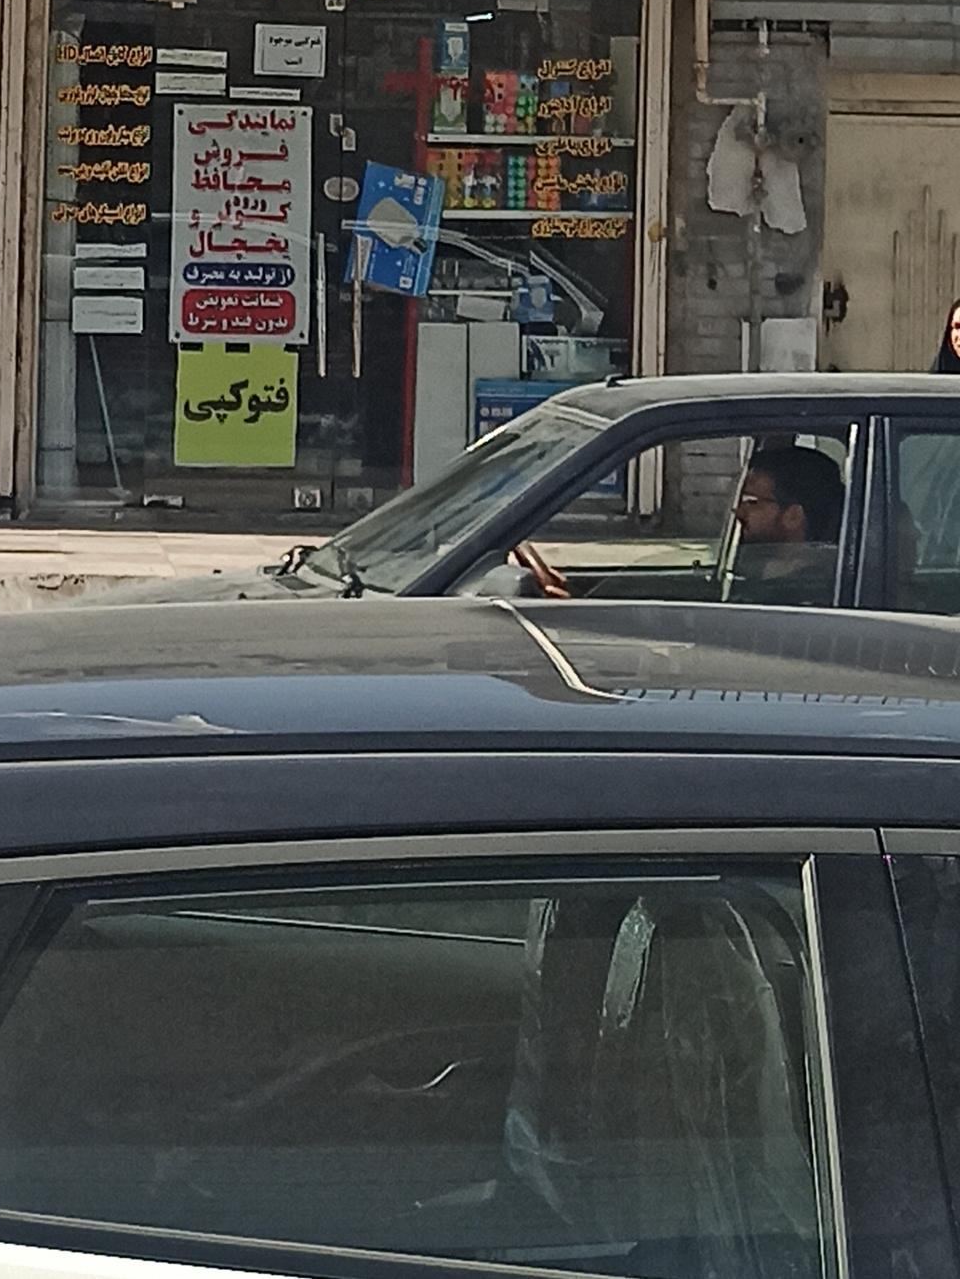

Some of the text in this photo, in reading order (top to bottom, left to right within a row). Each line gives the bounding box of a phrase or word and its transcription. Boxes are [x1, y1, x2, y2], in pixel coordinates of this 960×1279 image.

[188, 109, 296, 136] نمایندگی
[194, 139, 289, 167] فروش
[191, 168, 292, 192] محافظ
[184, 378, 290, 424] فتوکپی
